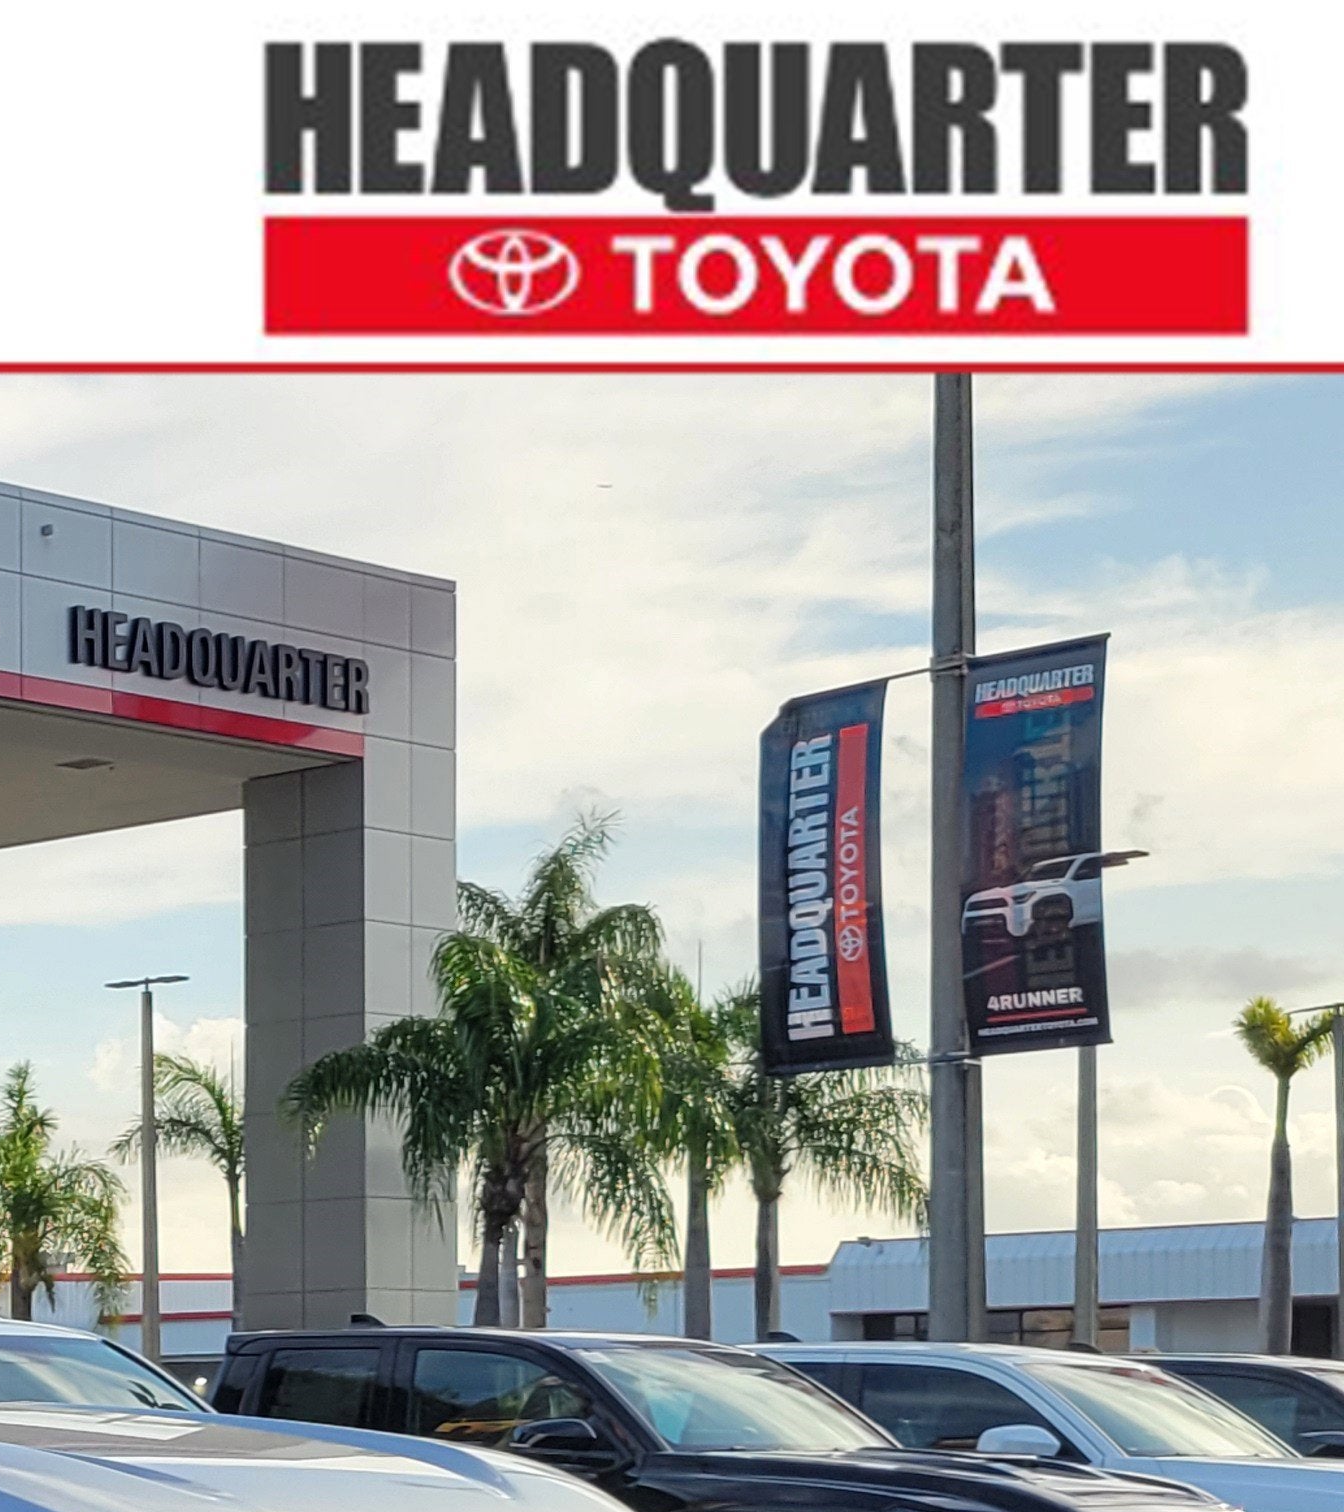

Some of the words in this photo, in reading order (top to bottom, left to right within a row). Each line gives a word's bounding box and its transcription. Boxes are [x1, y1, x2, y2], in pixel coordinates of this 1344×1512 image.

[70, 605, 370, 715] HEADQUARTER
[974, 663, 1094, 703] HEADQUARTER
[787, 733, 834, 1041] HEADQUARTER
[839, 806, 860, 922] TOYOTA
[987, 986, 1084, 1011] 4RUNNER
